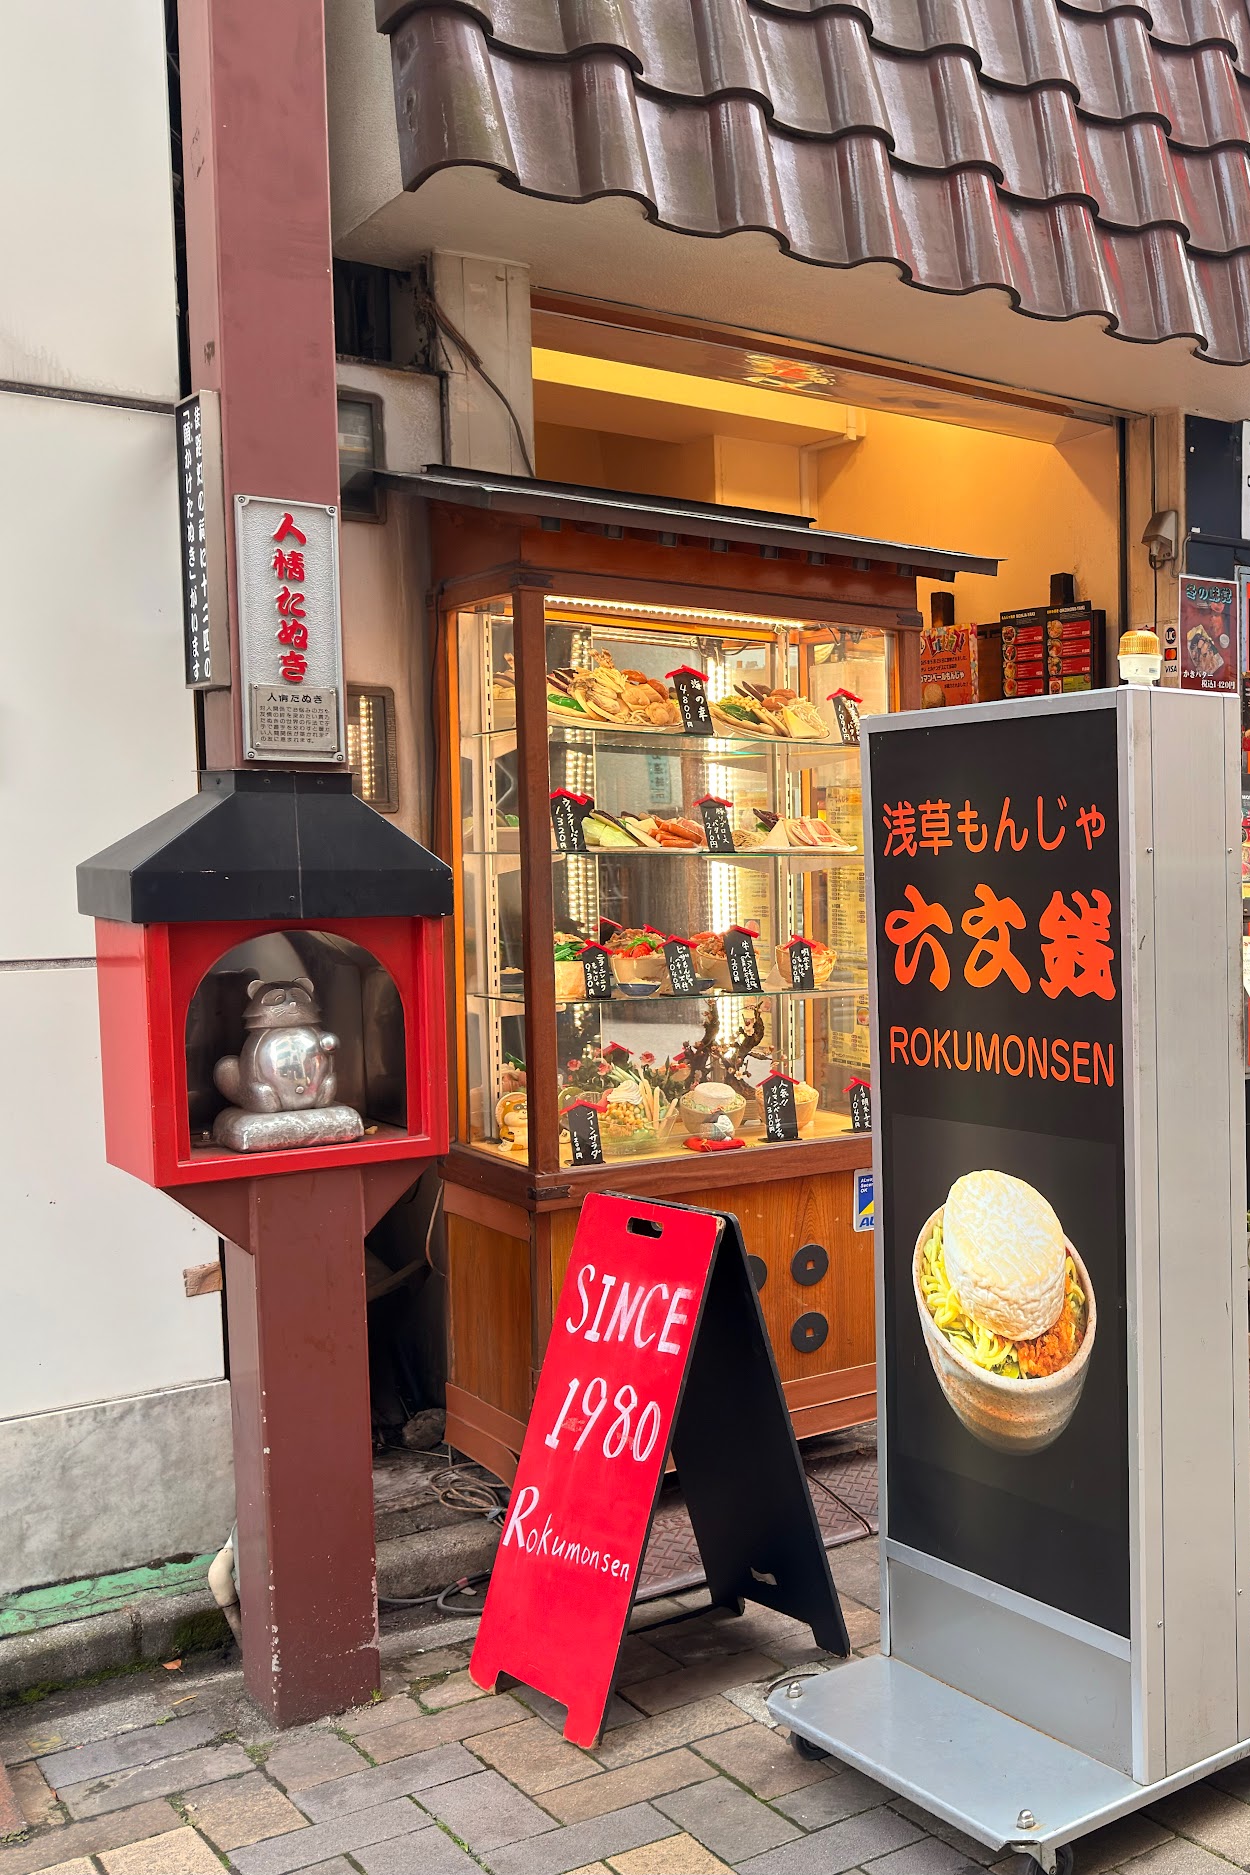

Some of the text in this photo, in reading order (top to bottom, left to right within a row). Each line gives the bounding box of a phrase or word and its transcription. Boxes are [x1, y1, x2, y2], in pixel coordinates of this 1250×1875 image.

[272, 512, 308, 683] 人情たぬき
[267, 693, 323, 704] 人情たぬき
[691, 679, 708, 722] 海の幸
[1165, 665, 1177, 673] VISA
[882, 795, 1107, 858] 浅草もんじゃ
[889, 1025, 1114, 1088] ROKUMONSEN
[587, 1111, 601, 1160] コーンサラダ
[565, 1262, 697, 1357] SINCE
[544, 1375, 662, 1464] 1980
[502, 1485, 630, 1583] Rokumonsen
